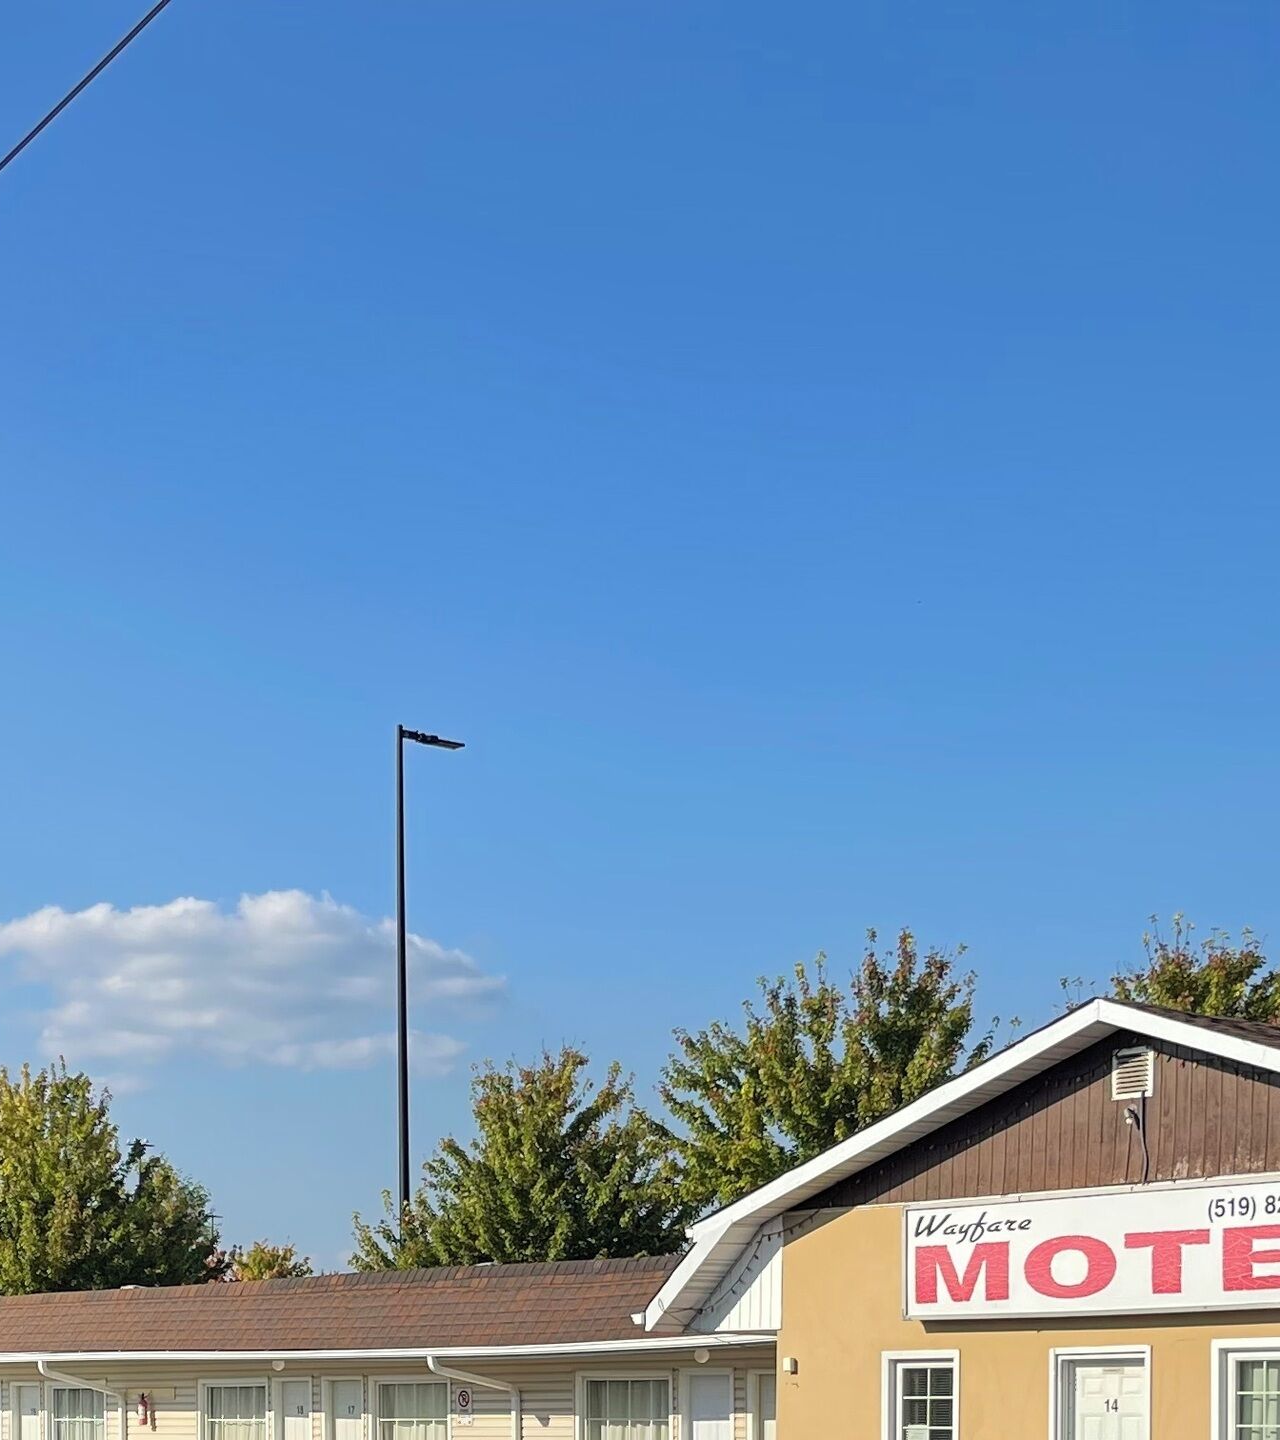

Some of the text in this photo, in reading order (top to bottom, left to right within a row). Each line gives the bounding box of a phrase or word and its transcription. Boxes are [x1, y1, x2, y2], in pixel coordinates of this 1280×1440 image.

[1207, 1196, 1257, 1222] (519)
[915, 1211, 1033, 1243] Wayfare
[1104, 1398, 1119, 1413] 14
